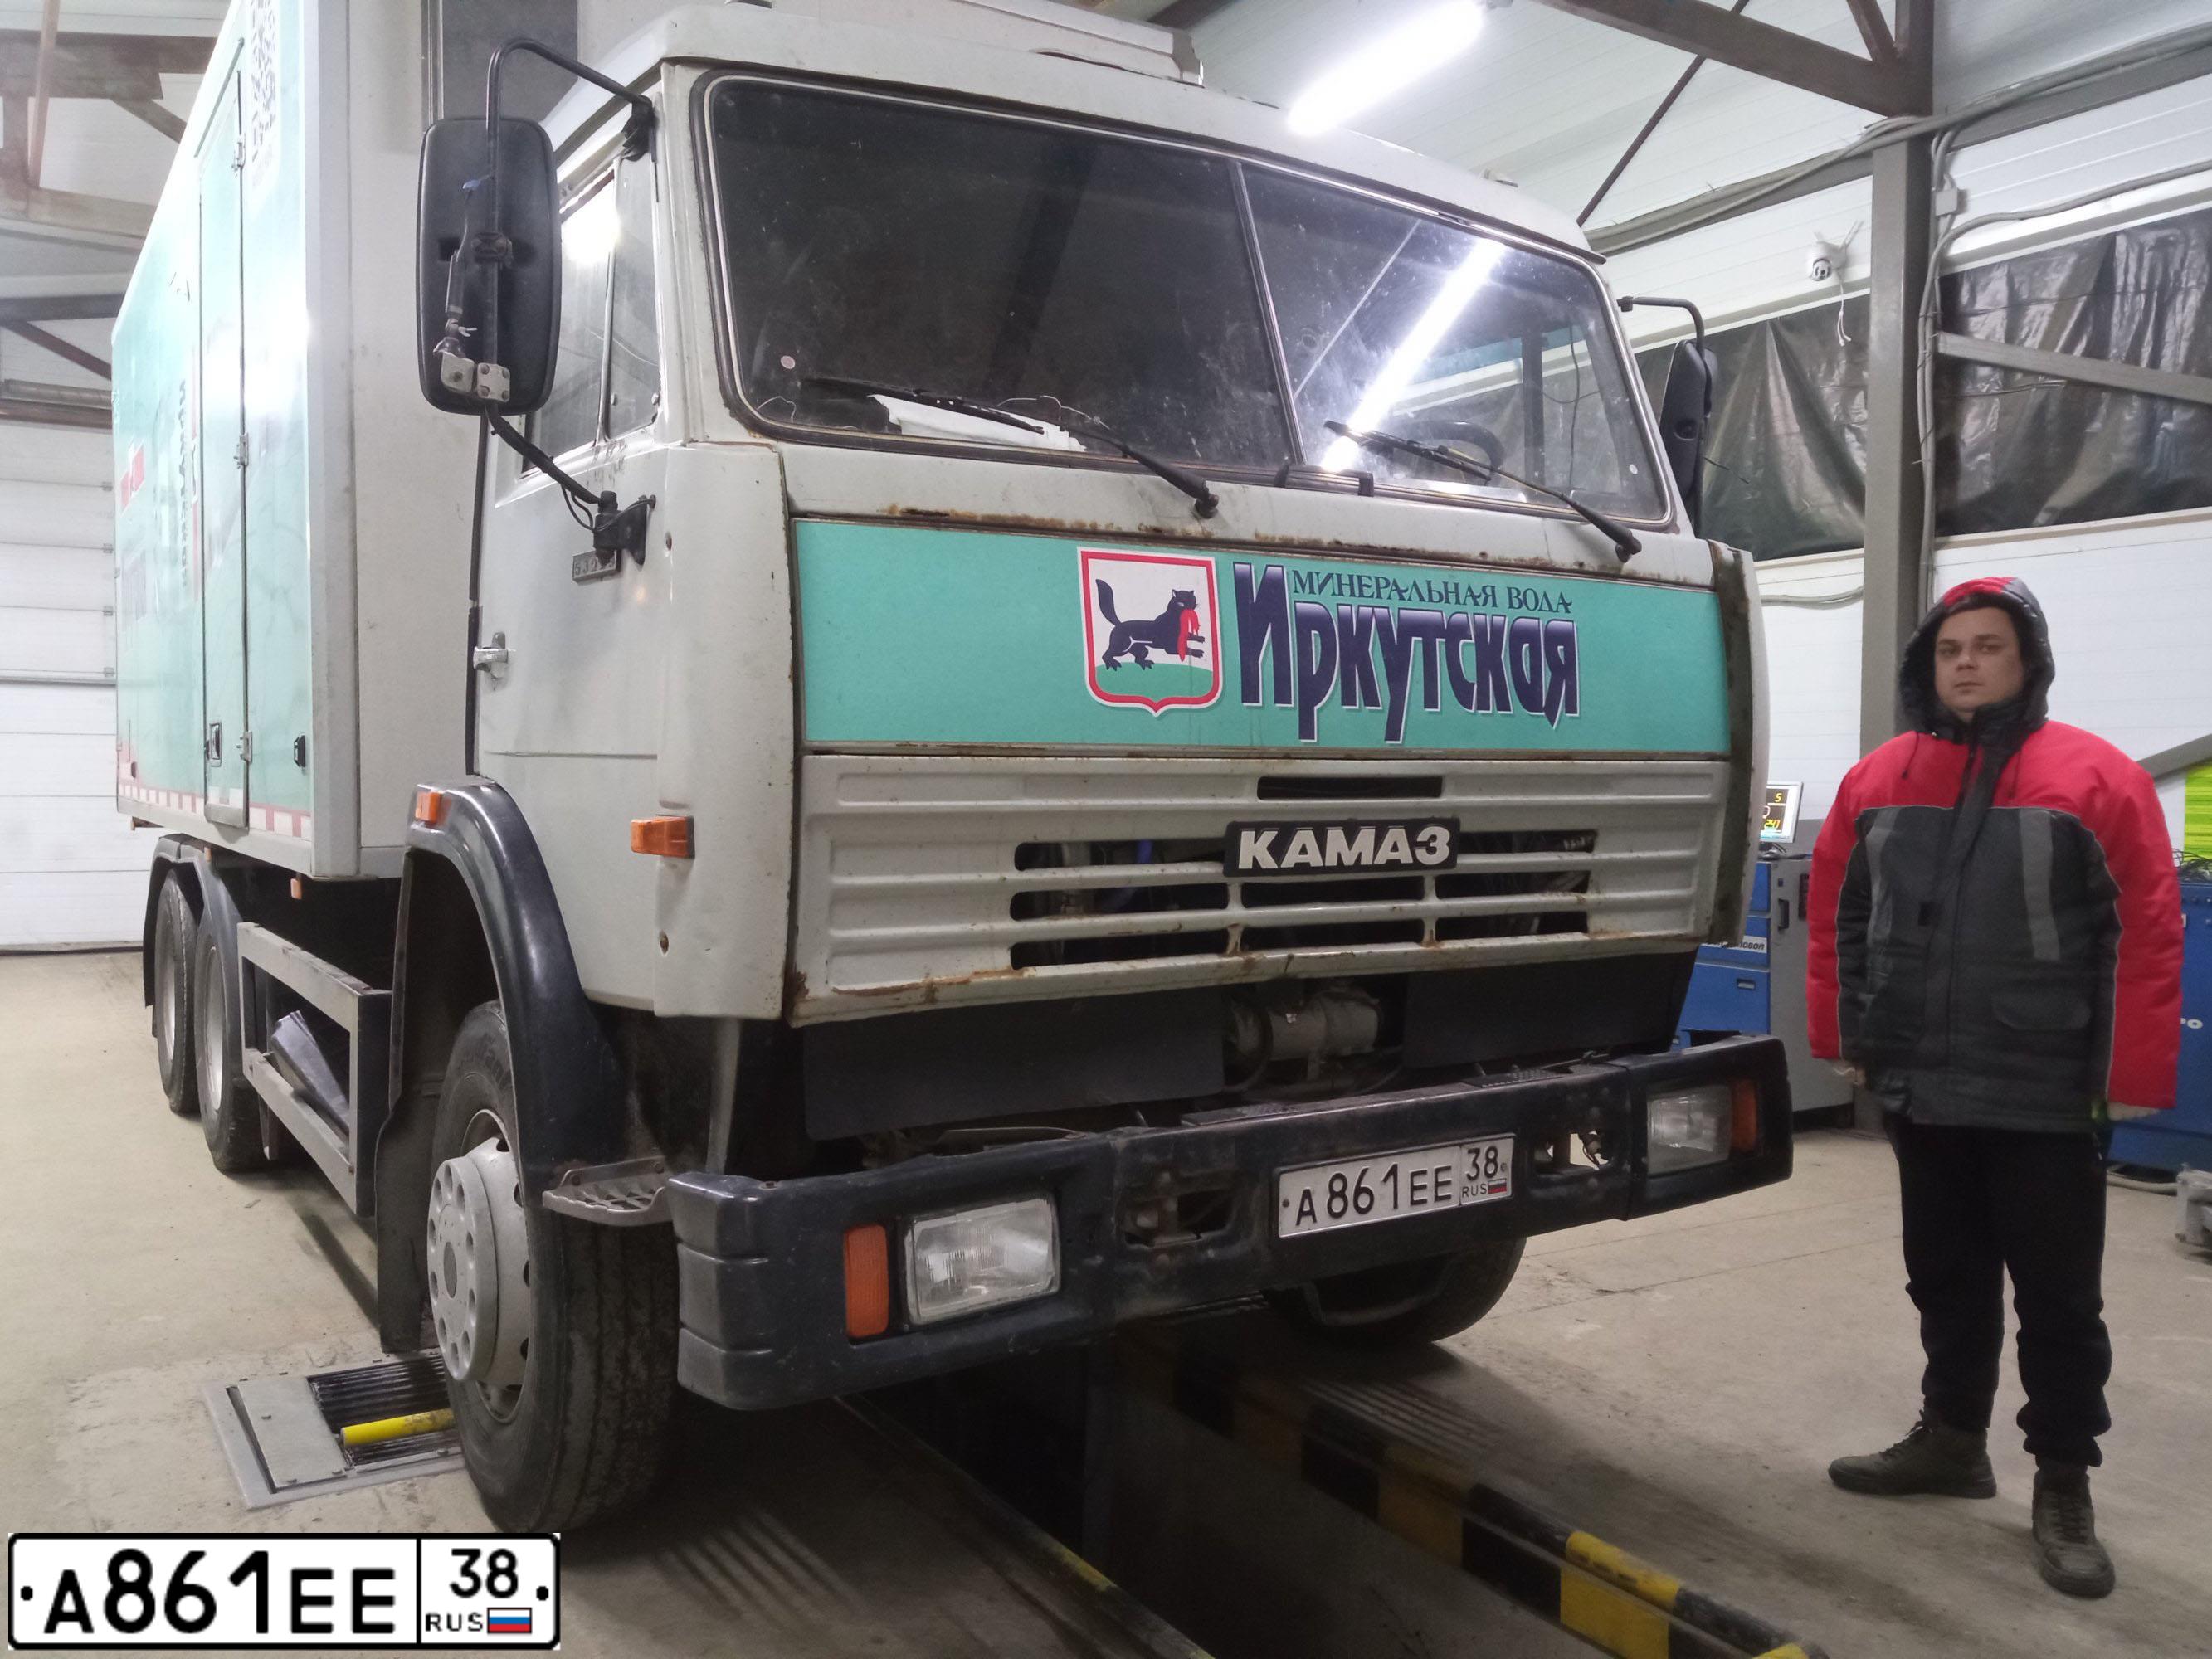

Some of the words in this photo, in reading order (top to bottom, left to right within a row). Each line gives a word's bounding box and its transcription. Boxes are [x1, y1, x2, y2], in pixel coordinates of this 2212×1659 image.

[1292, 569, 1498, 608] МИНЕРАЛЬНАЯ
[1506, 586, 1573, 614] ВОДА
[1233, 562, 1581, 744] Иркутская
[1238, 825, 1451, 870] КАМАЗ
[1465, 1146, 1499, 1181] 38
[1461, 1183, 1488, 1198] RUS
